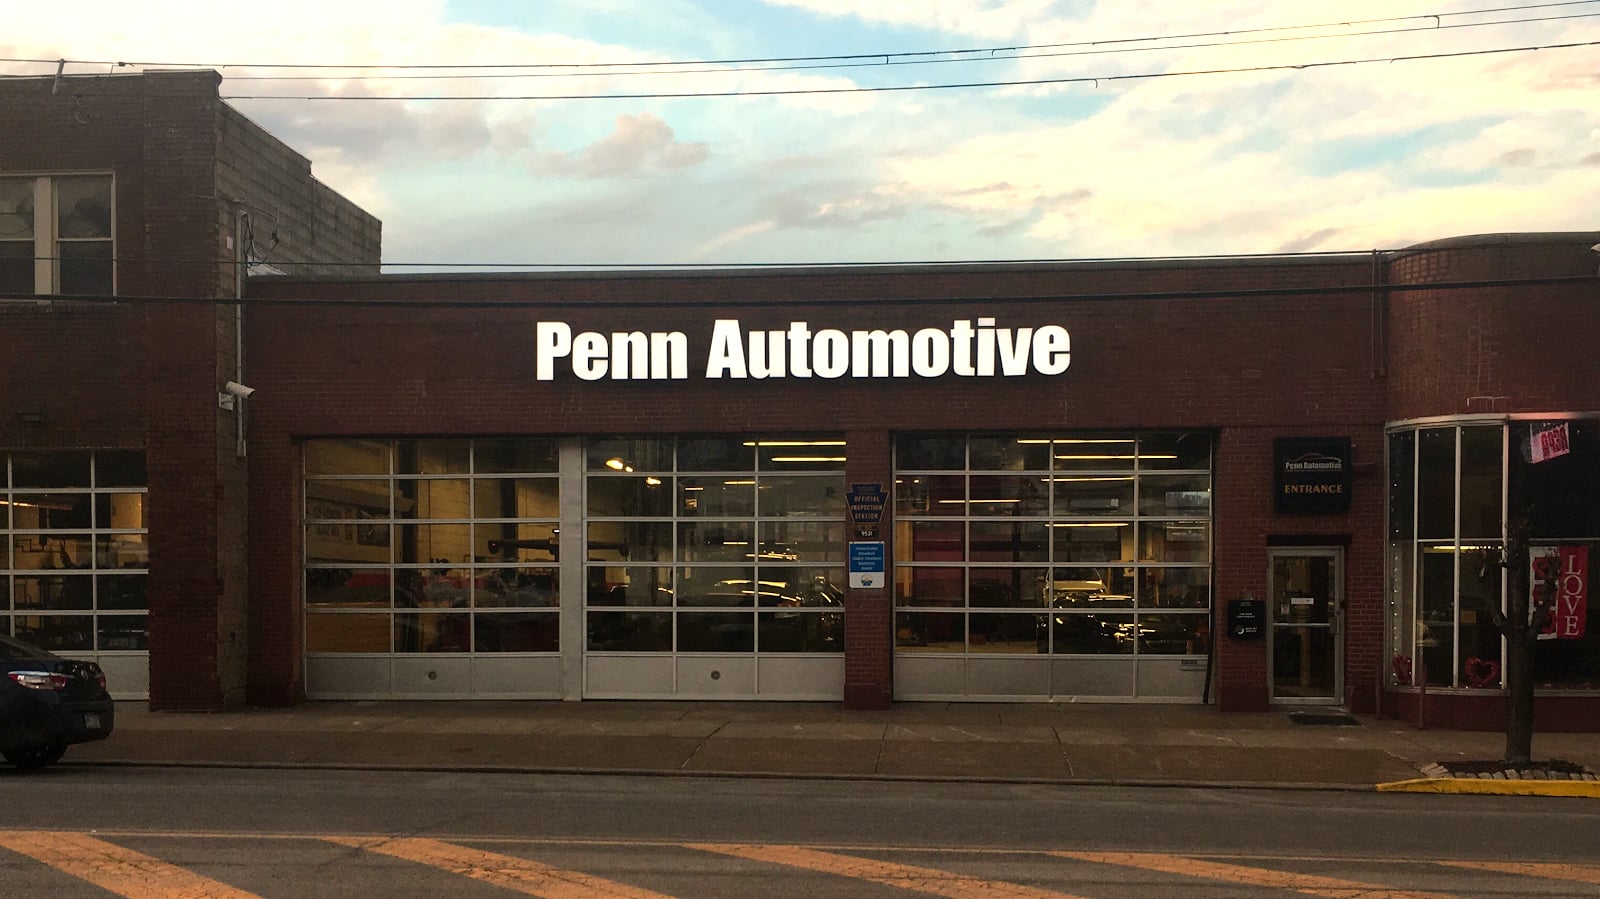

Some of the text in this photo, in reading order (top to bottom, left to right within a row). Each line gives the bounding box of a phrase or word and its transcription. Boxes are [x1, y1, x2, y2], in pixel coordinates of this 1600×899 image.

[536, 318, 1071, 381] Penn Automotive
[1285, 461, 1342, 469] Penn Automotive
[1284, 484, 1343, 494] ENTRANCE
[1562, 554, 1584, 637] LOVE
